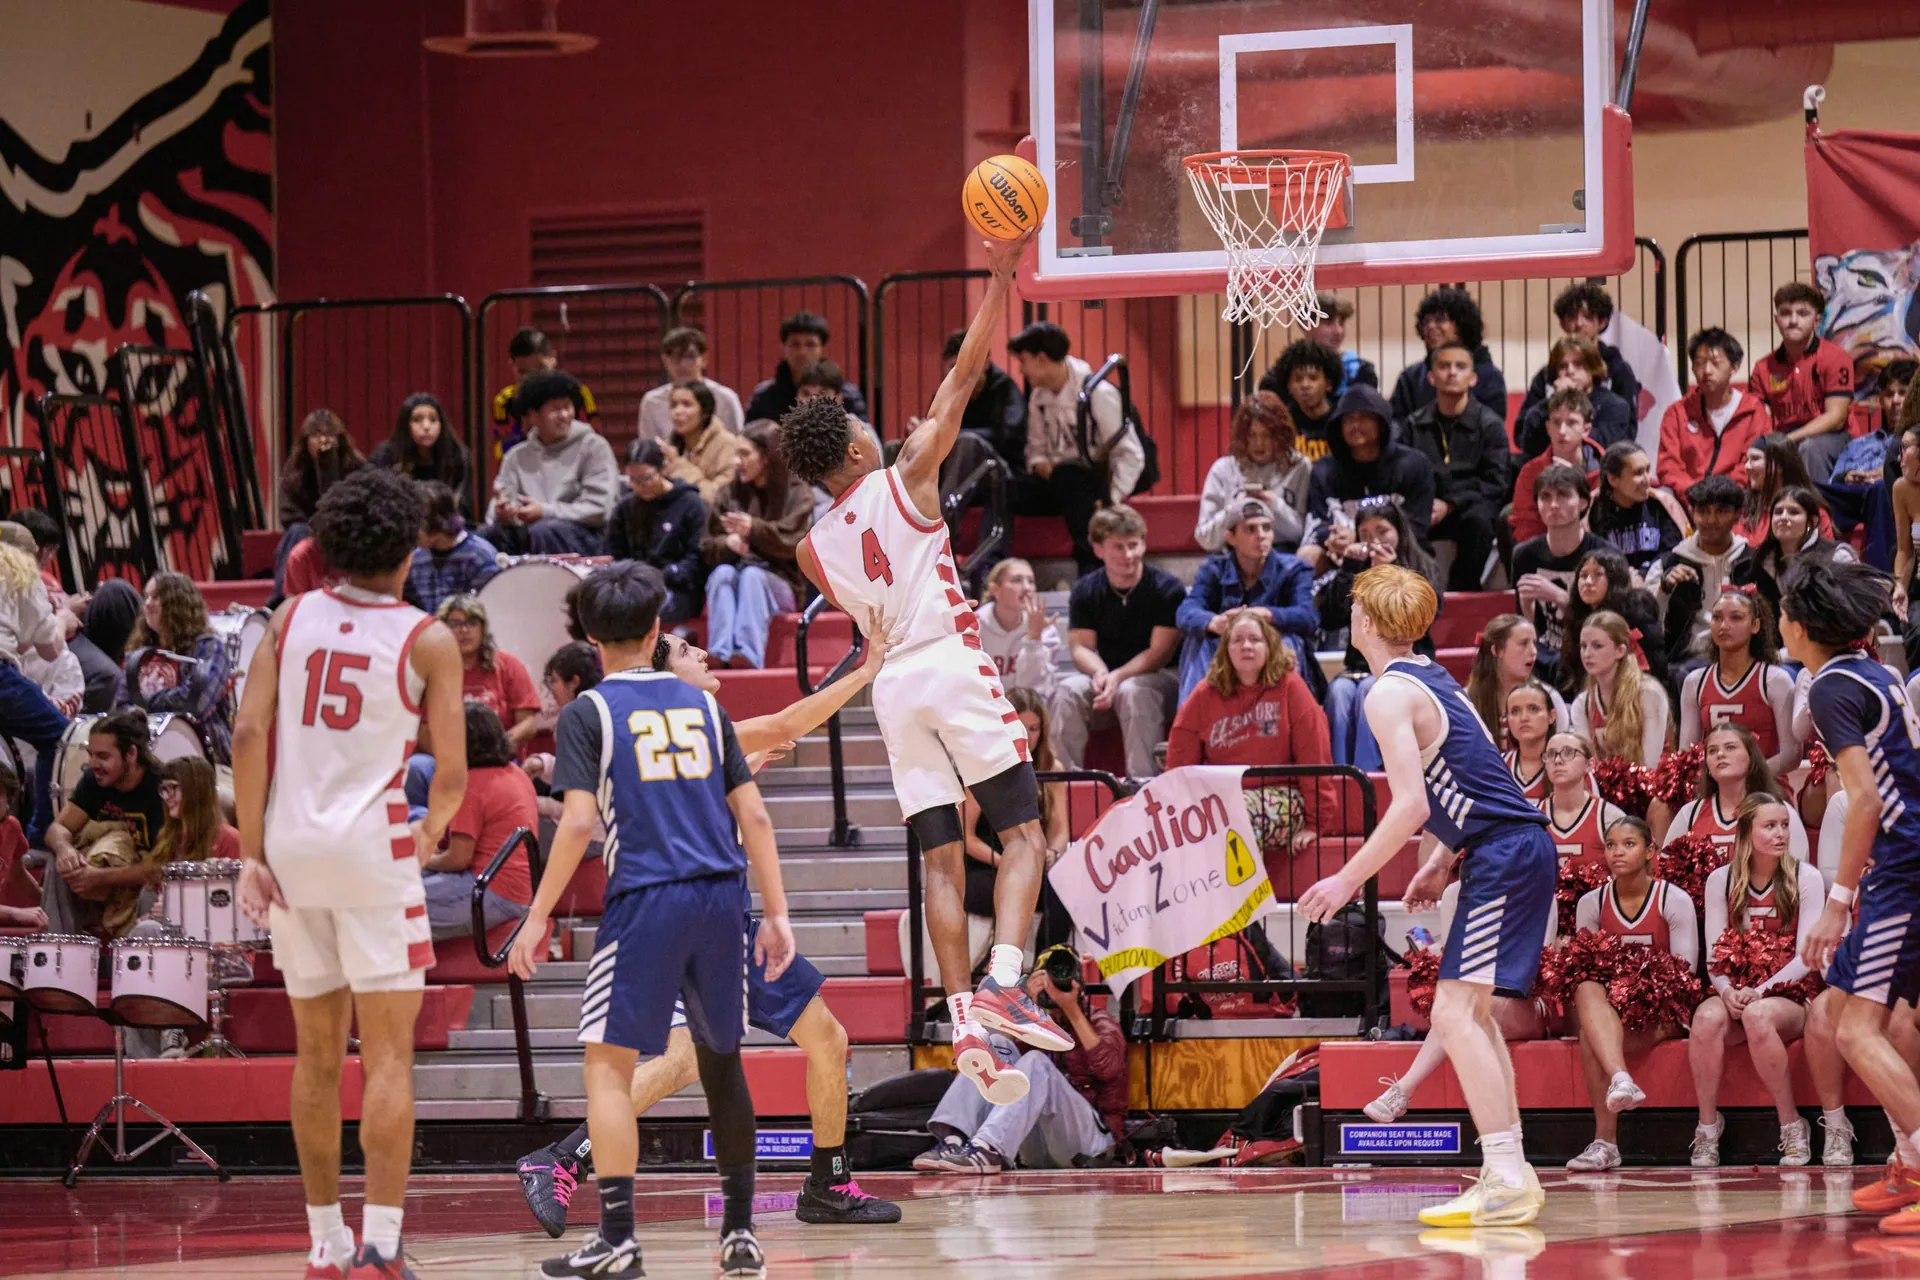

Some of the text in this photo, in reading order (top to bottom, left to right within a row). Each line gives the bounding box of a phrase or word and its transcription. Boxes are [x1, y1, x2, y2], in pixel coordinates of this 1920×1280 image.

[989, 171, 1029, 223] Wilson
[1838, 367, 1849, 386] 3
[861, 527, 894, 587] 4
[302, 648, 371, 731] 15
[627, 707, 713, 782] 25
[1084, 788, 1230, 894] Caution
[1083, 861, 1222, 951] Victory Zone
[765, 1136, 780, 1144] WILL
[781, 1136, 790, 1144] BE
[791, 1136, 809, 1144] MADE
[1349, 1130, 1452, 1138] COMPANION SEAT WILL BE MADE
[1357, 1139, 1443, 1147] AVAILABLE UPON REQUEST
